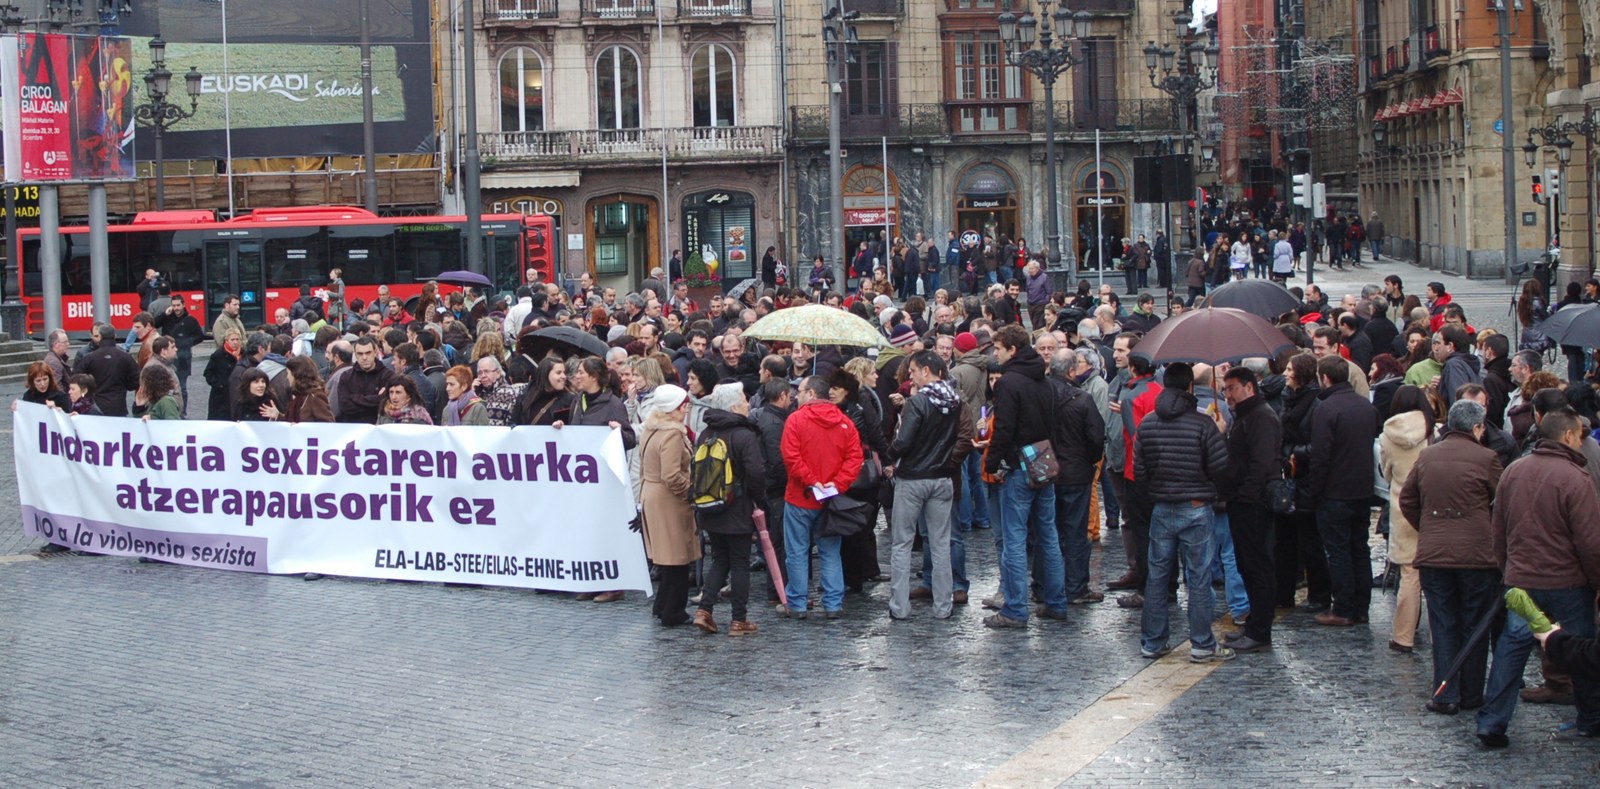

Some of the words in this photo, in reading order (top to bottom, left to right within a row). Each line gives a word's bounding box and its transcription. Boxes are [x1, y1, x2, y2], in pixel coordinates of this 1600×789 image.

[21, 86, 52, 99] CIRCO
[200, 74, 308, 93] EUSKADI
[315, 80, 380, 98] Saboréaa
[22, 100, 67, 114] BALAGAN
[23, 187, 39, 200] 13
[0, 207, 41, 217] AHADA
[518, 201, 557, 216] TILO
[68, 302, 132, 318] Bilbus
[39, 422, 225, 472] Indarkeria
[241, 438, 457, 479] sexistaren
[472, 442, 599, 484] aurka
[116, 478, 434, 526] atzerapausorik
[450, 496, 496, 525] ez
[34, 513, 53, 538] NO
[58, 527, 67, 542] a
[73, 523, 93, 547] la
[99, 529, 185, 559] violencia
[192, 542, 256, 567] sexista
[375, 549, 619, 581] ELA-LAB-STEE/EILAS-EHNE-HIRU
